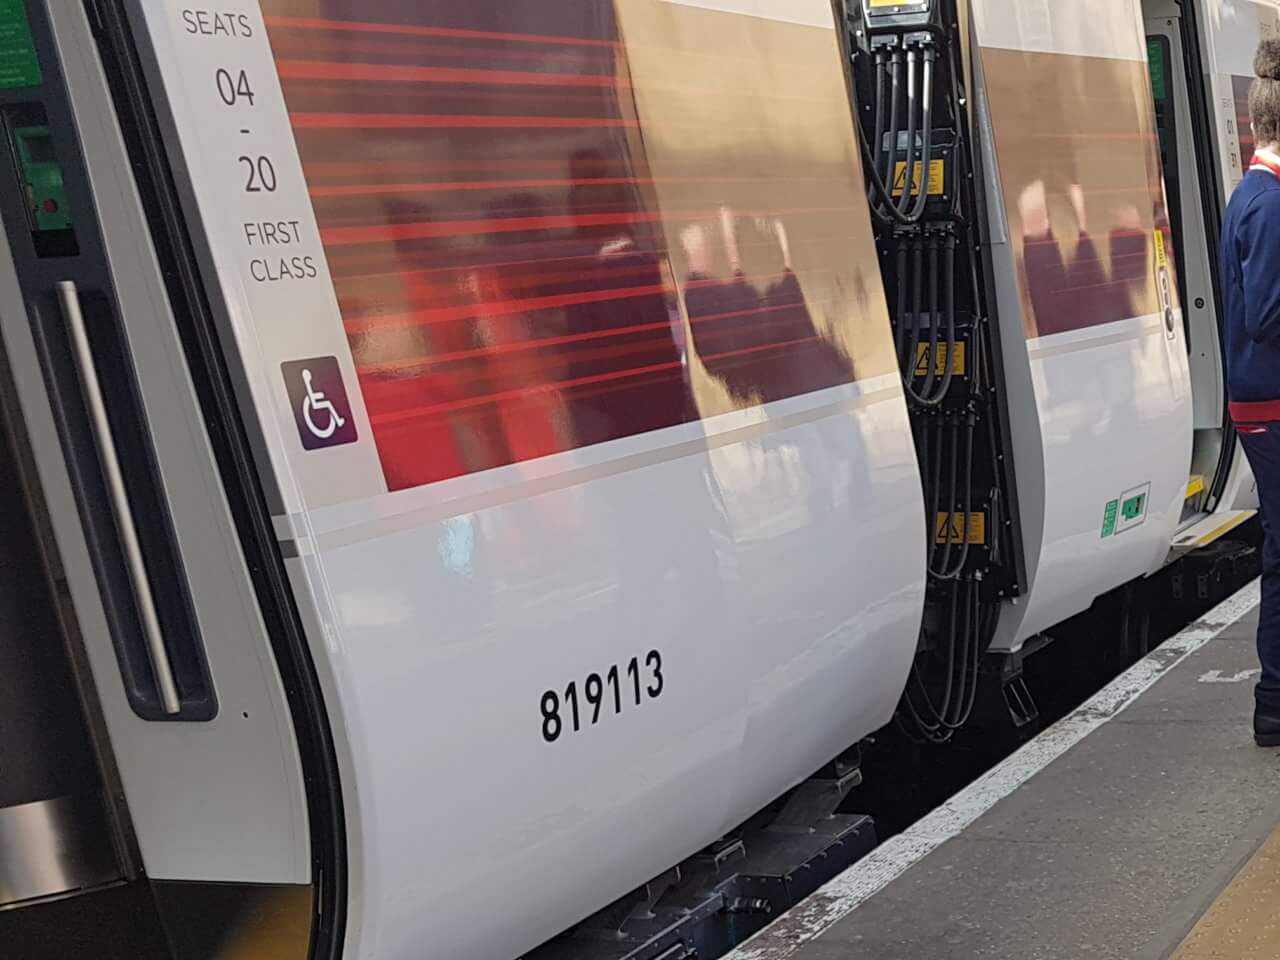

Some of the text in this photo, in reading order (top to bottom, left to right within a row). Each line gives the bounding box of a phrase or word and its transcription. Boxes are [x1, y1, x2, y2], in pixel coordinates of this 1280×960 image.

[182, 9, 252, 38] SEATS
[216, 68, 254, 106] 04
[238, 155, 276, 192] 20
[244, 221, 300, 245] FIRST
[250, 256, 317, 282] CLASS
[540, 649, 663, 743] 819113
